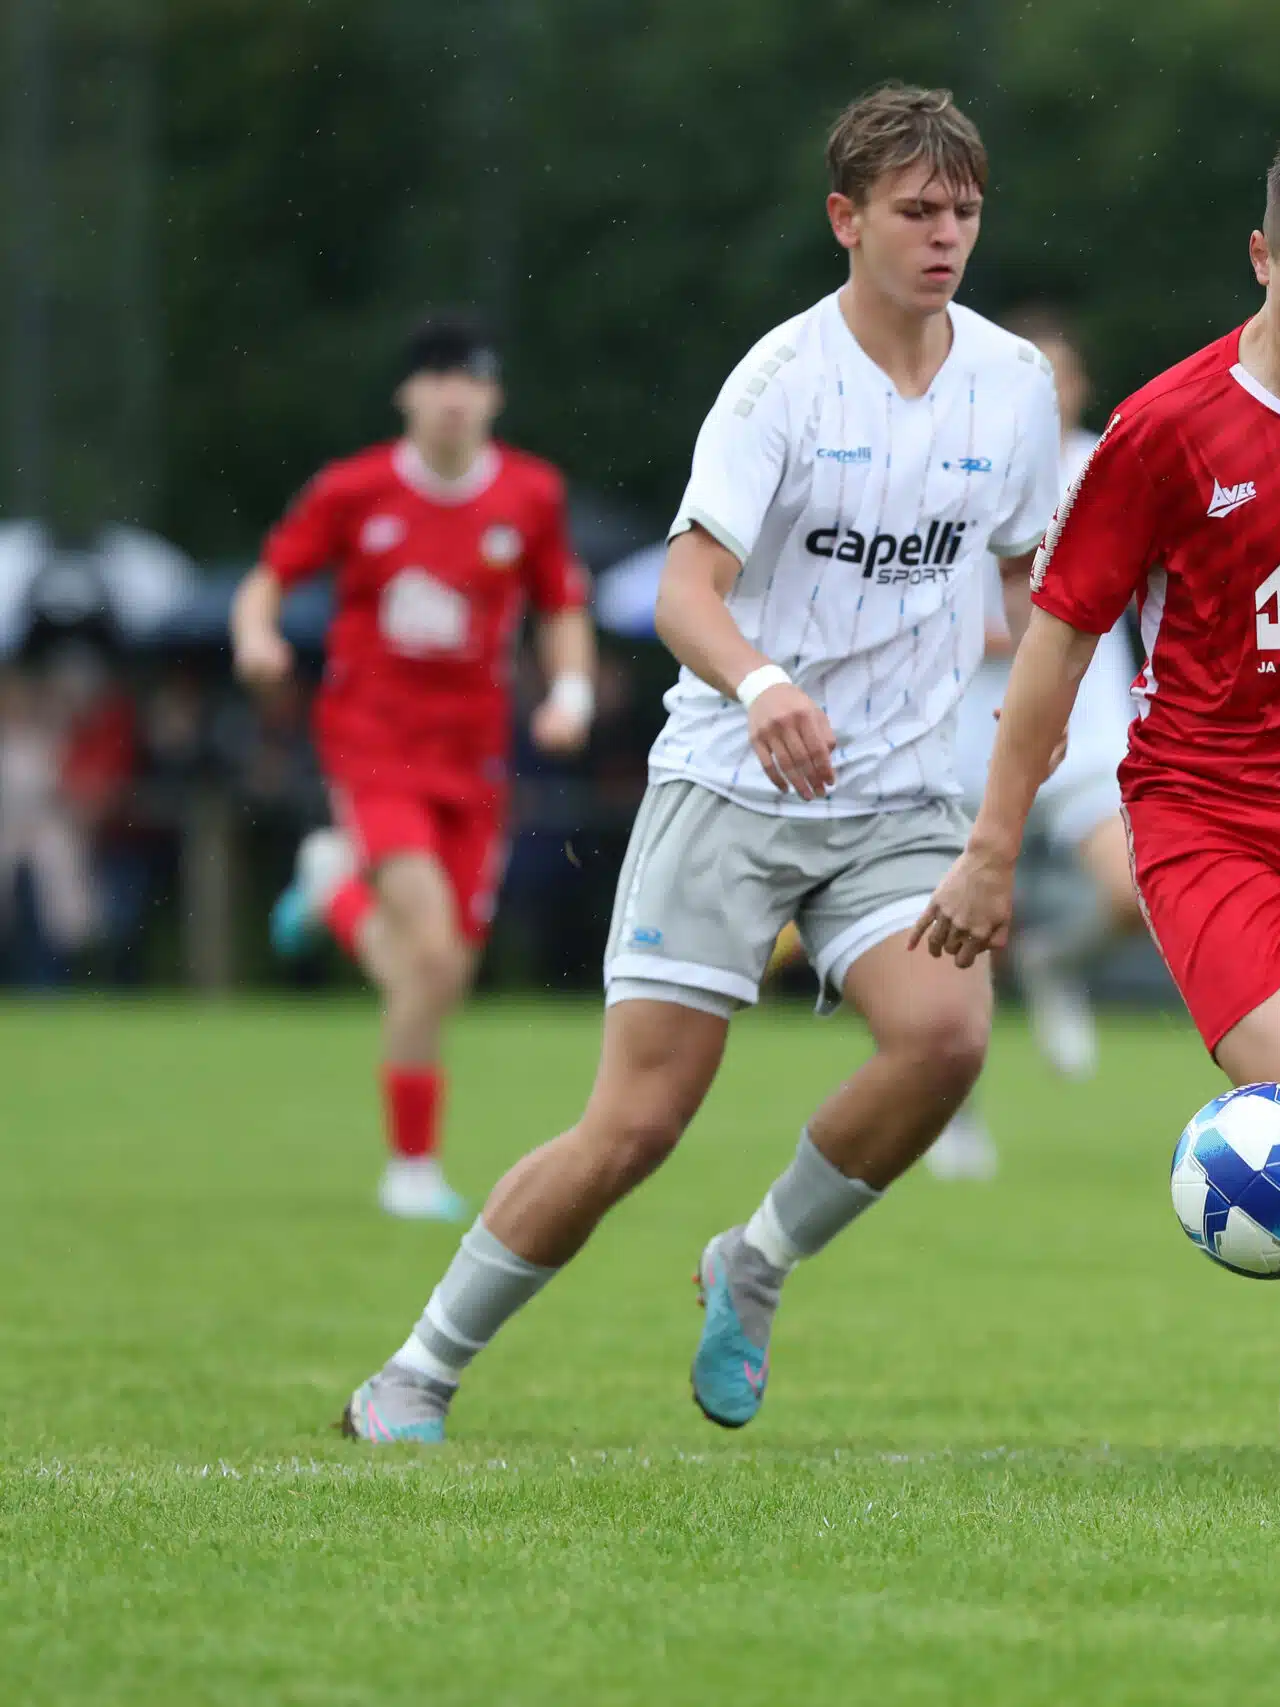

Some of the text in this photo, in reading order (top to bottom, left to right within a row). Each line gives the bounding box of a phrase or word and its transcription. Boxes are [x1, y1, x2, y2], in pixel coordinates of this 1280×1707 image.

[806, 520, 967, 578] capelli
[876, 568, 956, 585] SPORT
[1257, 660, 1276, 673] JA
